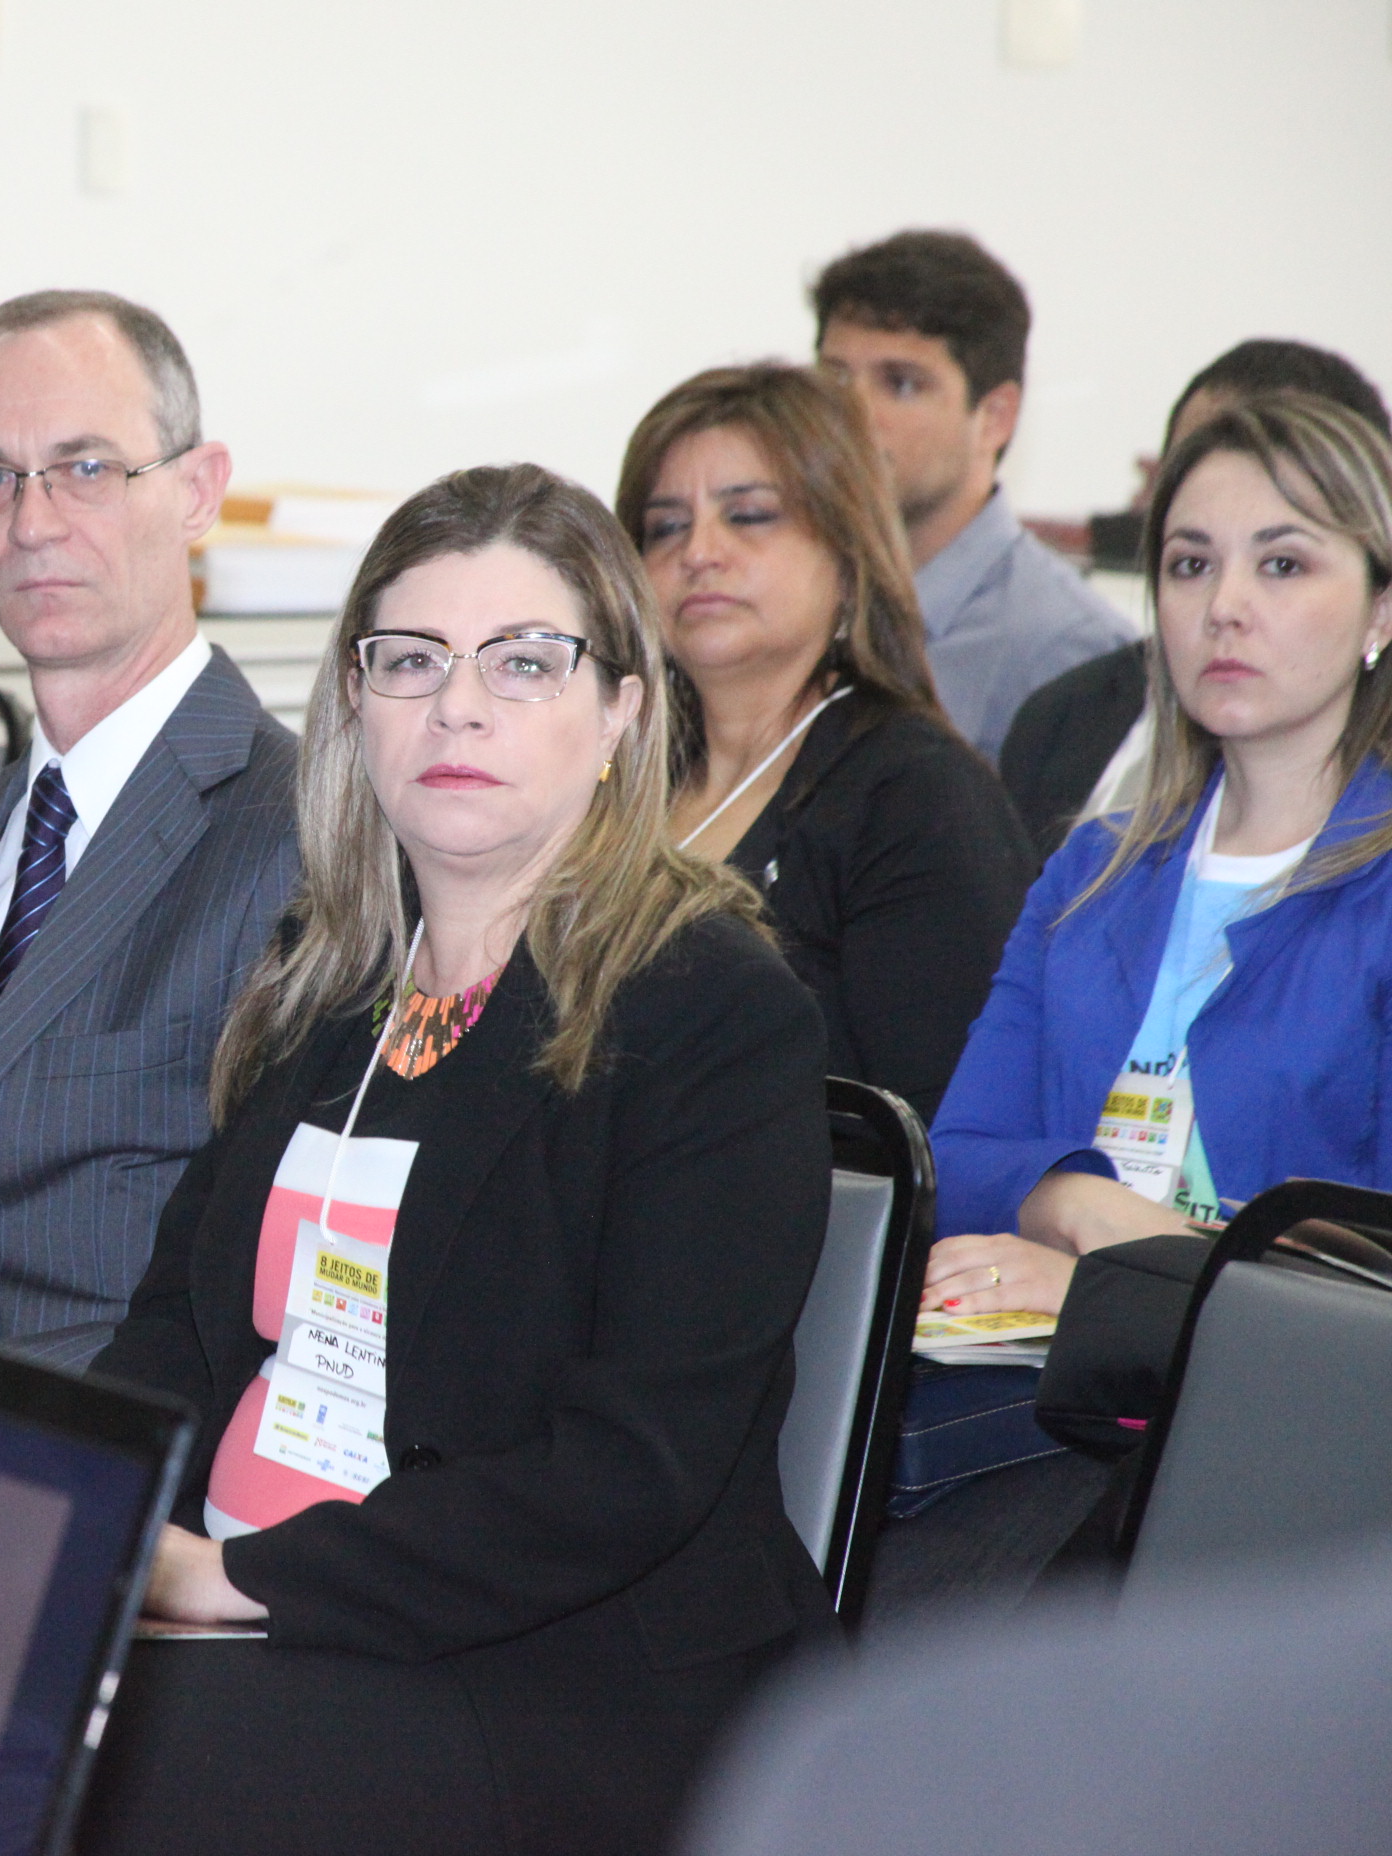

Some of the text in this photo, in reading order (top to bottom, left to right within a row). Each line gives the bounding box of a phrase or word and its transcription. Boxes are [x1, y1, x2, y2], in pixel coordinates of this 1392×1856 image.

[320, 1256, 378, 1286] 8 JEITOS DE
[320, 1267, 343, 1282] MUDAR
[352, 1279, 377, 1294] MUNDO
[308, 1329, 339, 1348] NENA
